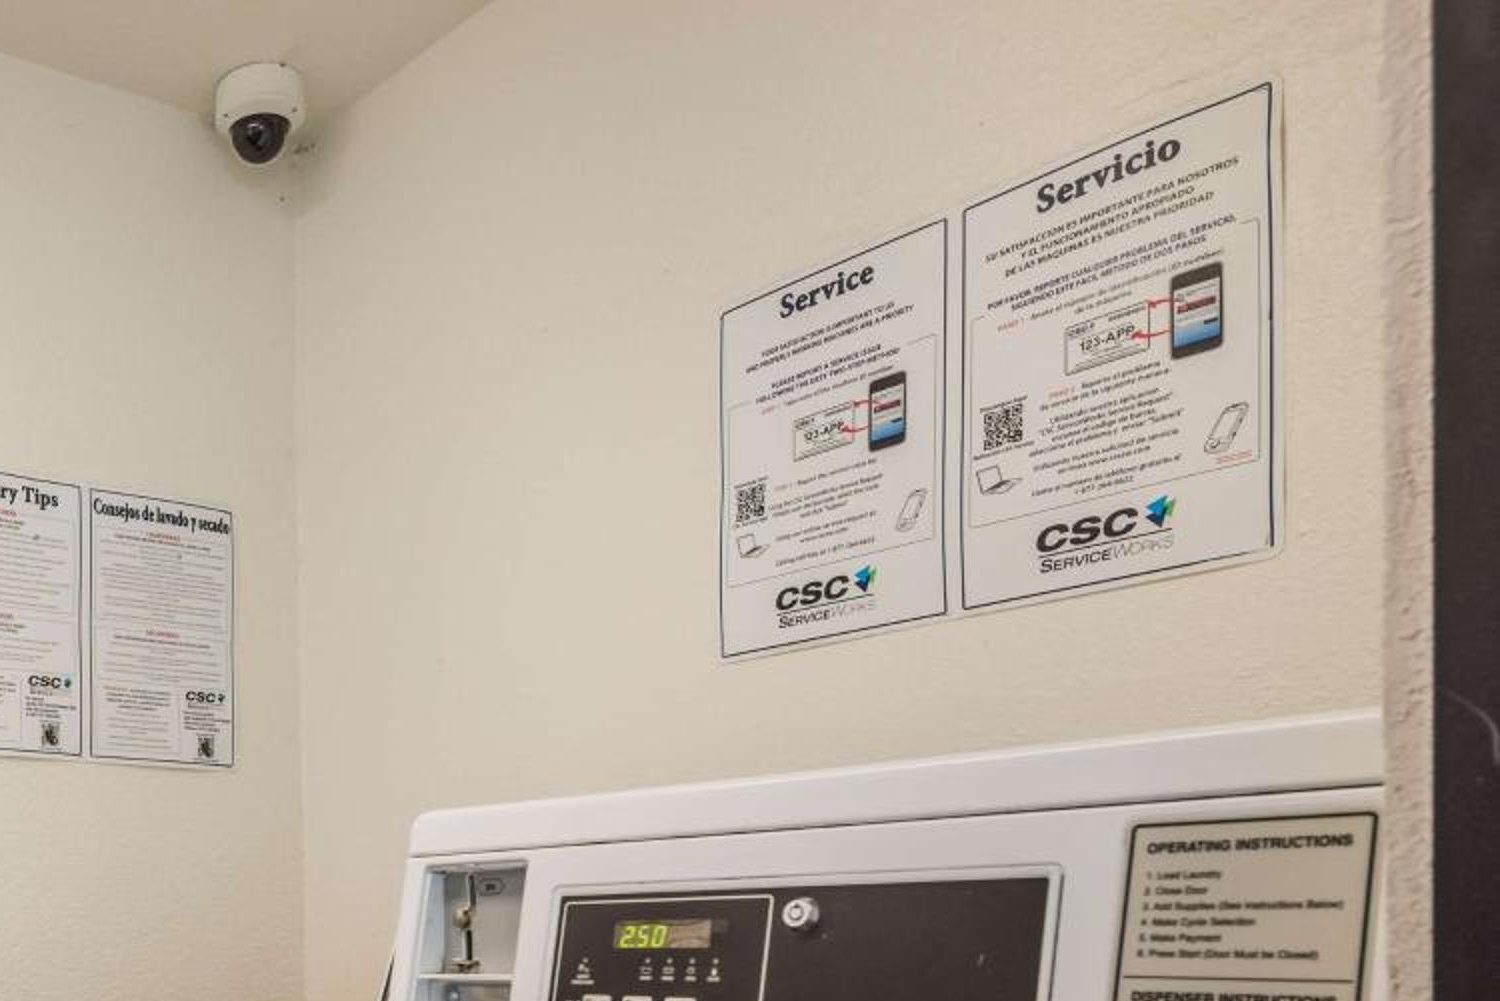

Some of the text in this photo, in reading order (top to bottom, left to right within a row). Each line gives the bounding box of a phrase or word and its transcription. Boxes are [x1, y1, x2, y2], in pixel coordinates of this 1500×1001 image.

[1036, 138, 1180, 213] Servicio
[1146, 180, 1174, 201] PARA
[1177, 155, 1238, 189] NOSOTROS
[780, 265, 875, 319] Service
[1080, 325, 1135, 352] 123-APP
[21, 485, 58, 509] Tips
[93, 498, 139, 522] Consejos
[141, 504, 154, 521] de
[156, 508, 189, 527] lavado
[198, 515, 230, 535] secado
[1036, 507, 1138, 553] CSC
[776, 574, 849, 612] CSC
[28, 675, 62, 689] CSC
[185, 690, 216, 703] CSC
[1146, 833, 1354, 854] OPERATING INSTRUCTIONS
[618, 924, 669, 949] 250
